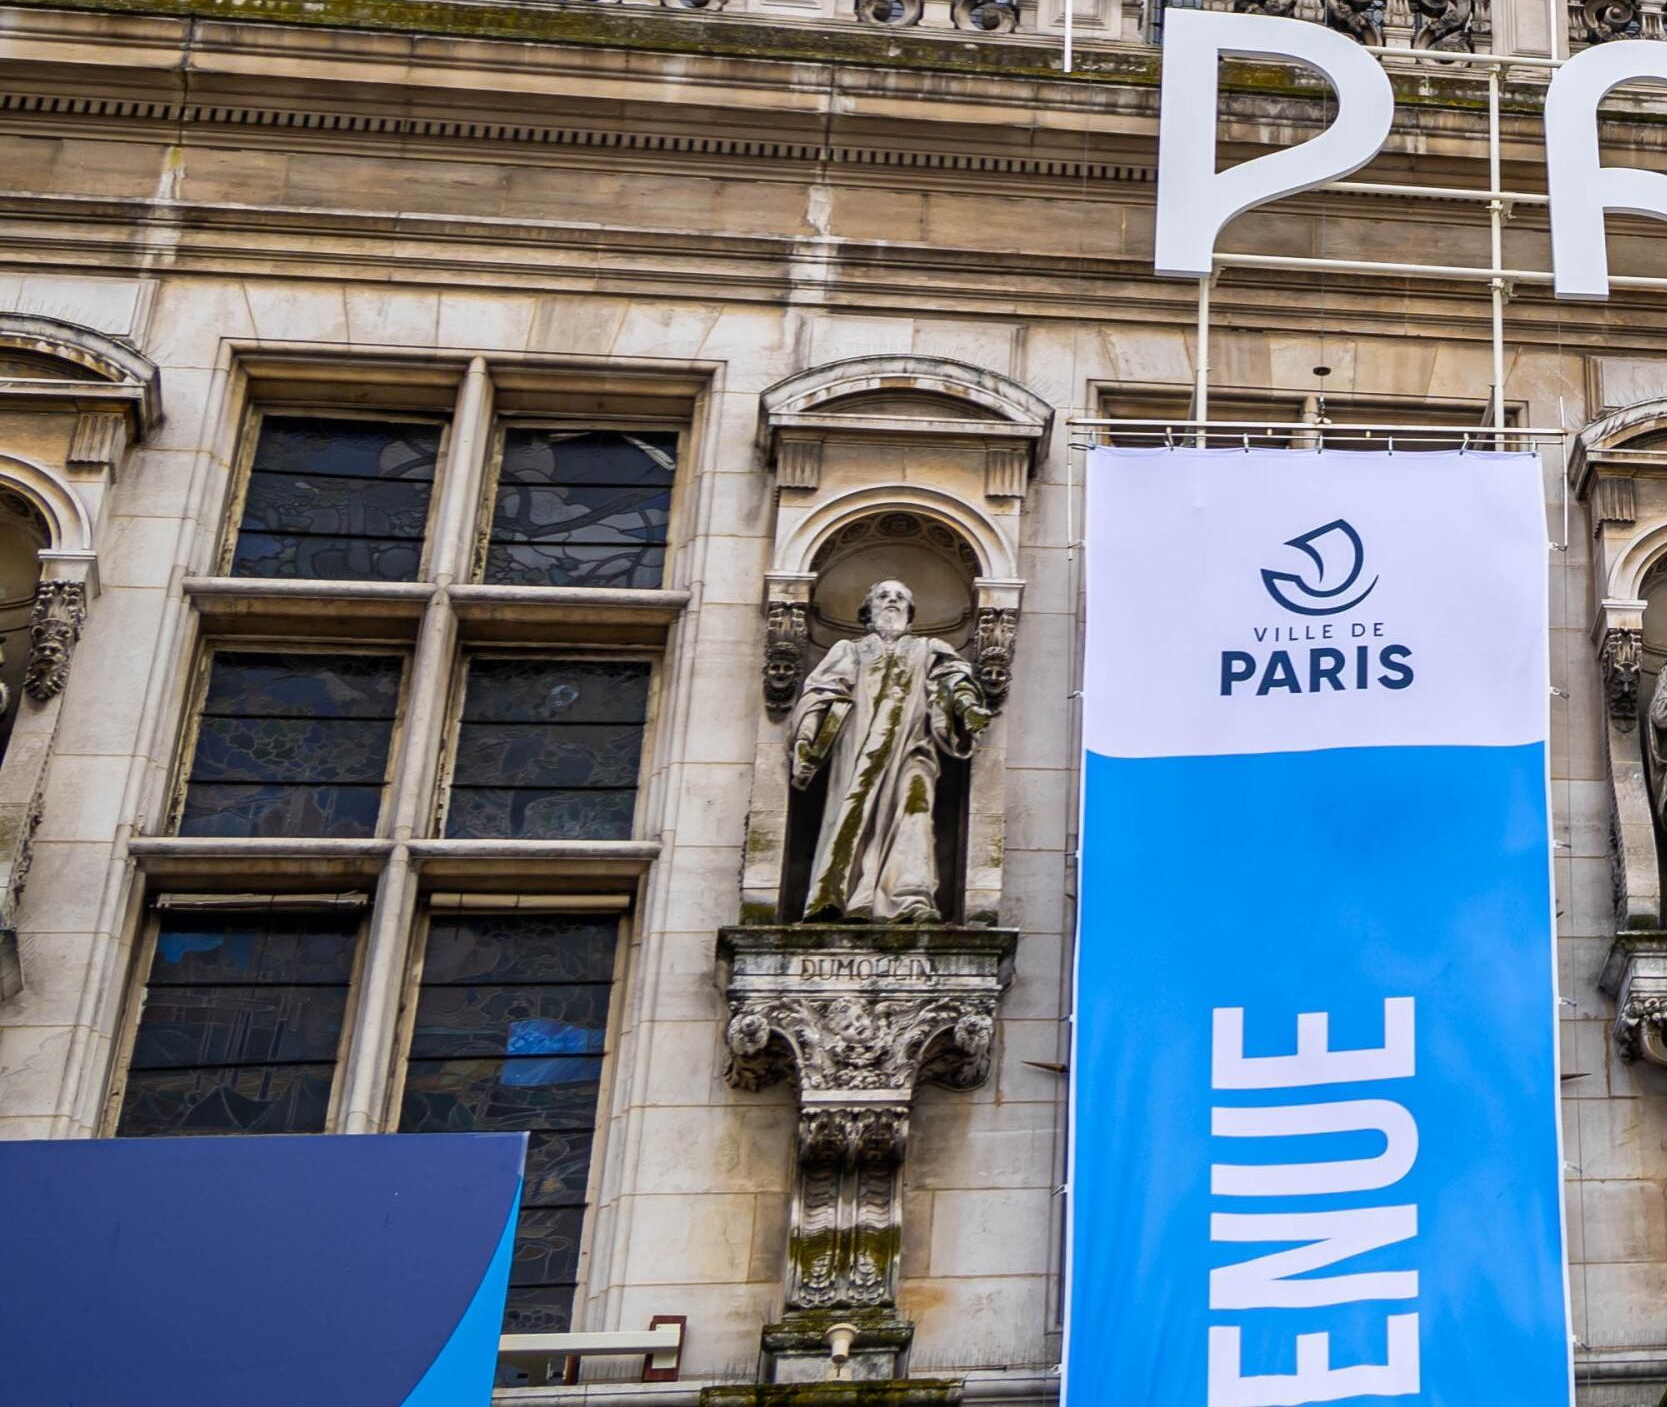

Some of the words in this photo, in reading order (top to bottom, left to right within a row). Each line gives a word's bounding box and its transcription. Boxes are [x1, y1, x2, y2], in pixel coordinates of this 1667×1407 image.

[1254, 624, 1334, 642] VILLE
[1352, 622, 1384, 637] DE
[1220, 644, 1414, 696] PARIS
